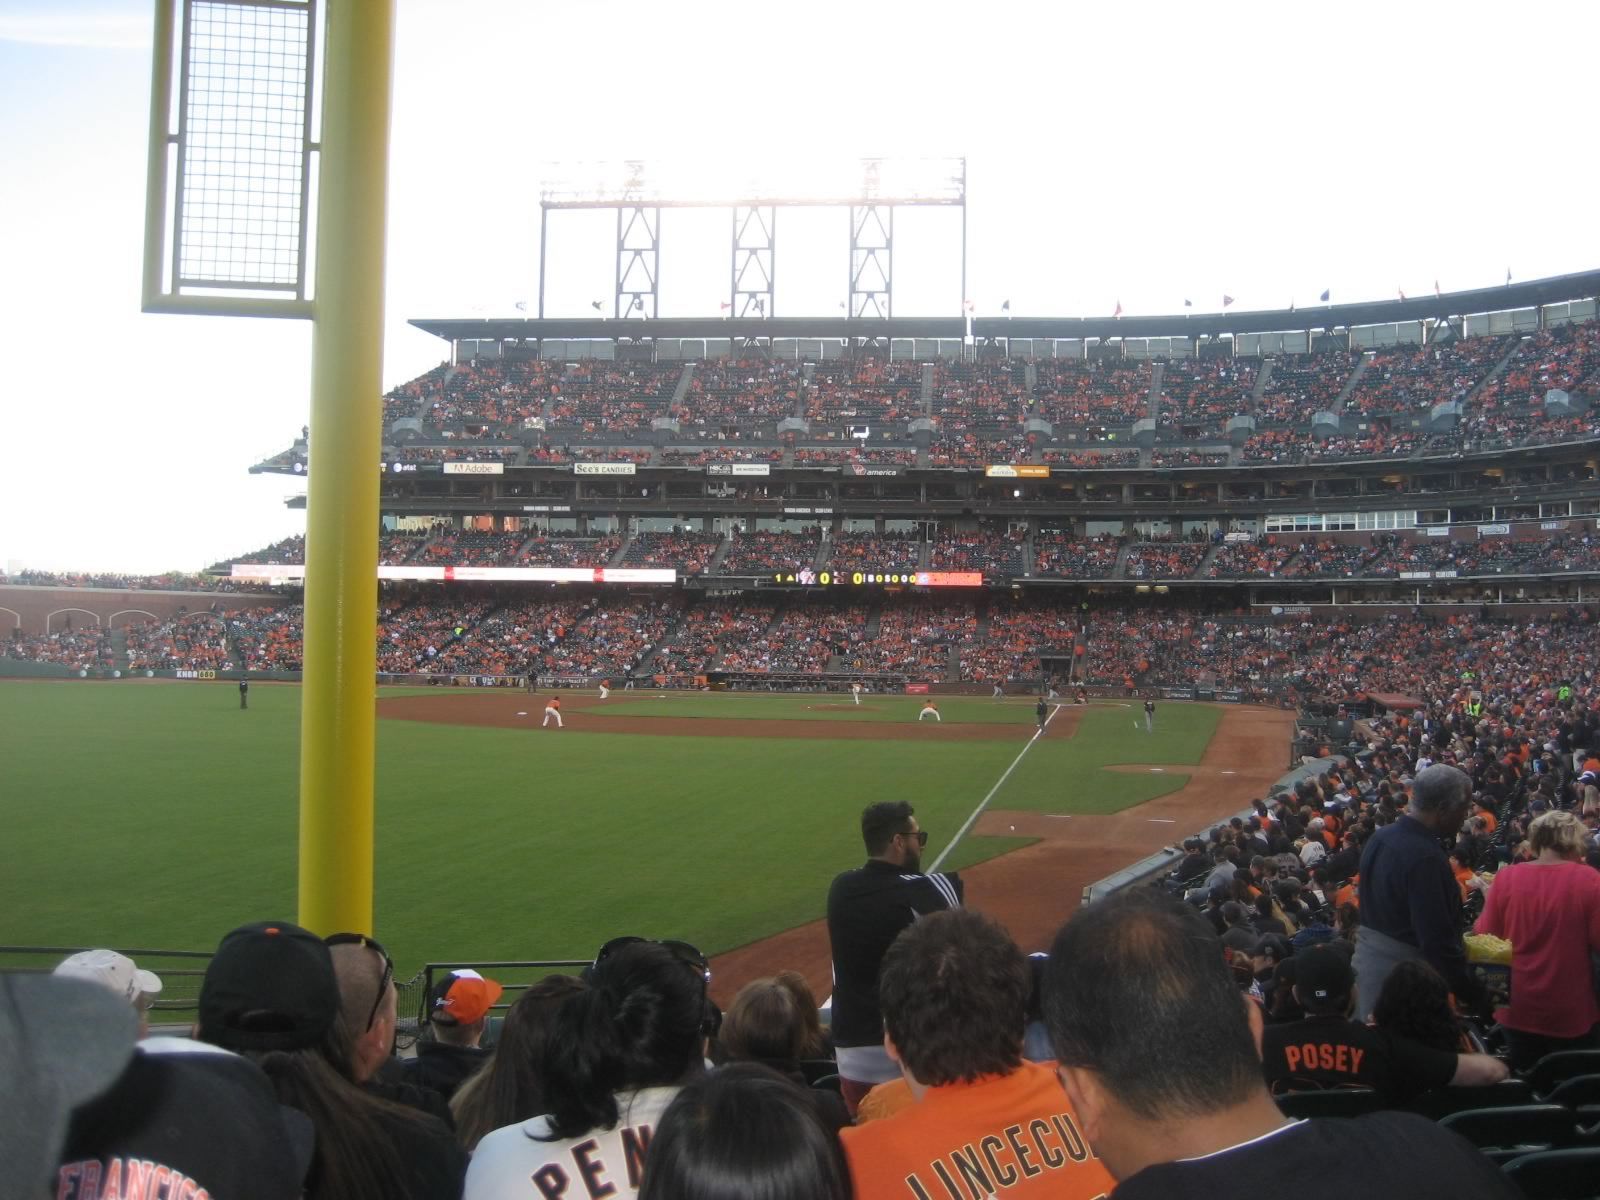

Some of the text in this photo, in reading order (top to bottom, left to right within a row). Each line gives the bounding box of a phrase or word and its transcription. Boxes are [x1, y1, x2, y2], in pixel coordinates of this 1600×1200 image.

[465, 463, 493, 473] Adobe
[576, 464, 632, 474] See's CANDIES
[866, 468, 897, 476] america
[820, 572, 830, 584] 0
[853, 572, 863, 584] 0
[1285, 1043, 1365, 1074] POSEY
[905, 1113, 1100, 1200] INCECU
